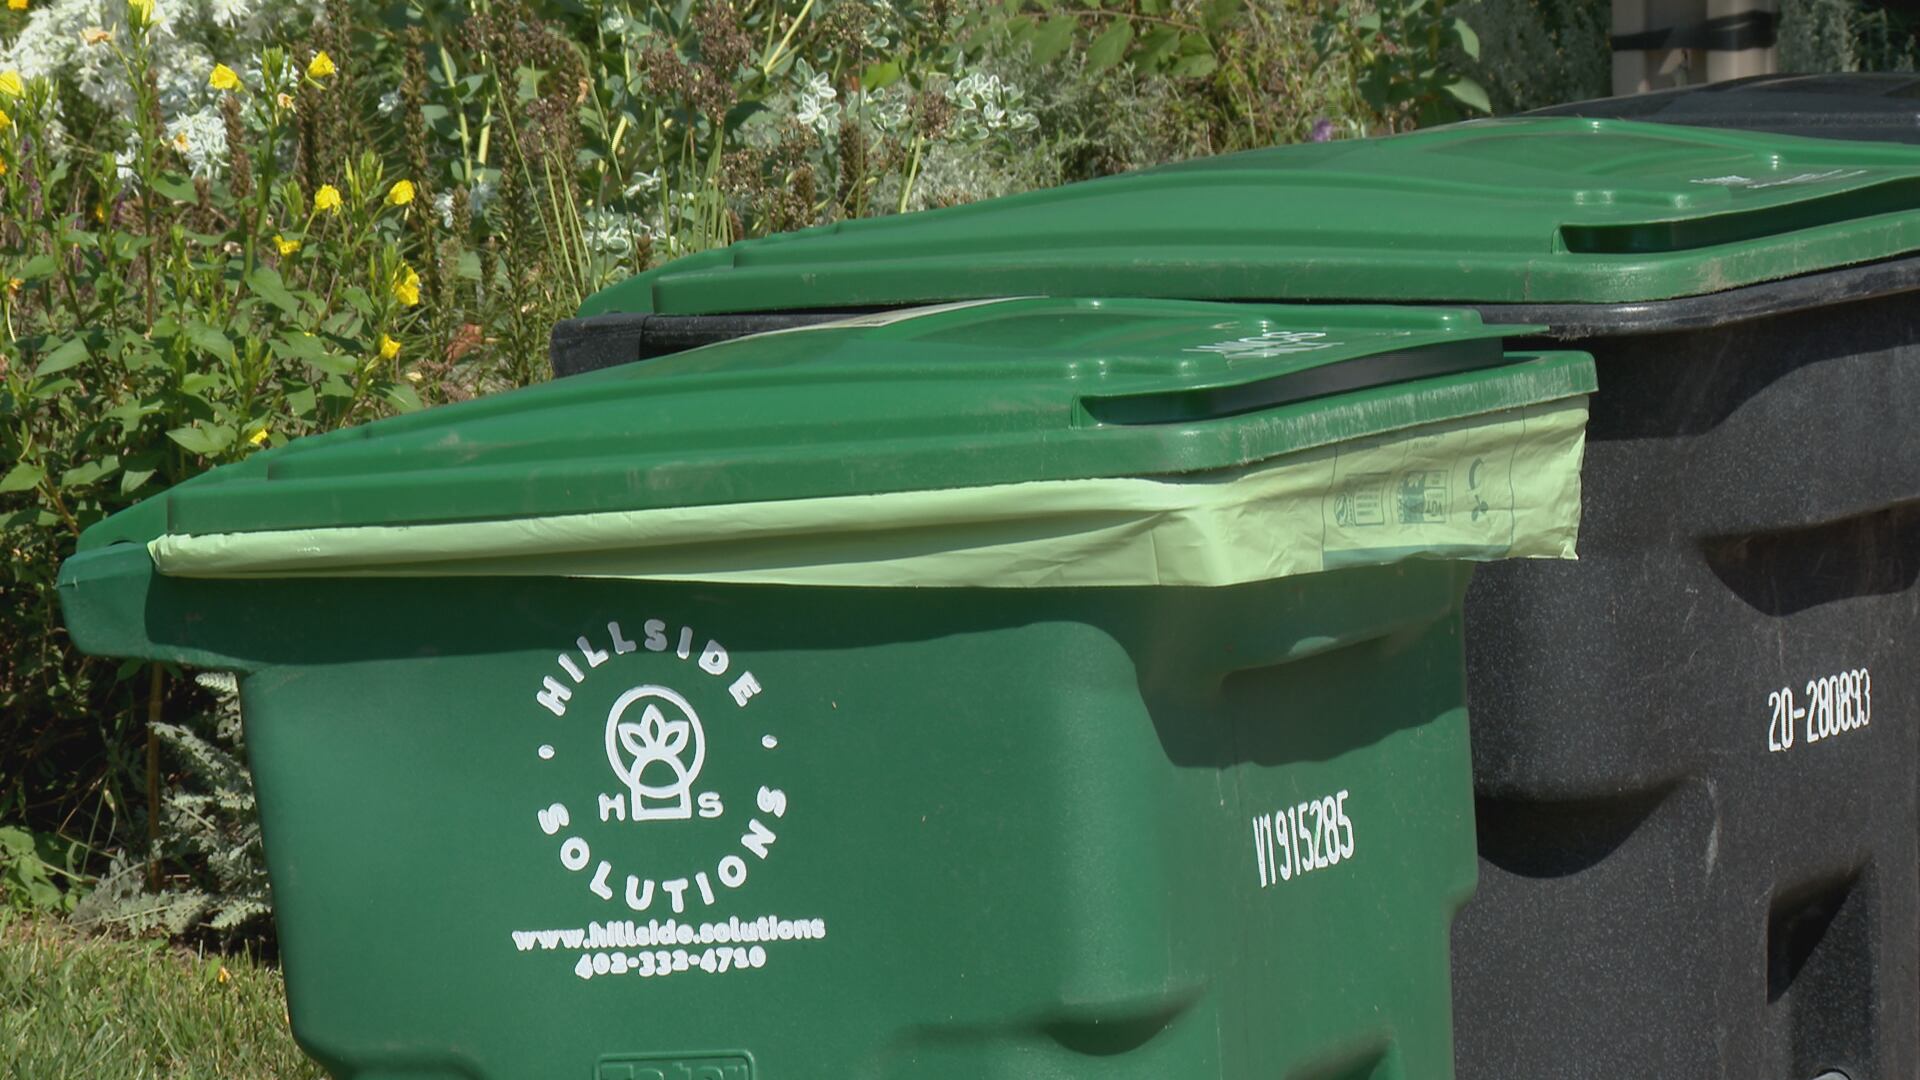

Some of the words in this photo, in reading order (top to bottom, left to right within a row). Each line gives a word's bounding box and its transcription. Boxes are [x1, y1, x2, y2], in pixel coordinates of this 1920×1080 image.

[537, 619, 762, 716] HILLSIDE
[1768, 668, 1870, 752] 20-280893
[538, 786, 787, 912] SOLUTIONS
[1252, 789, 1354, 888] V1915285
[511, 915, 826, 951] www.hillside.solutions
[575, 945, 767, 979] 402-332-4710
